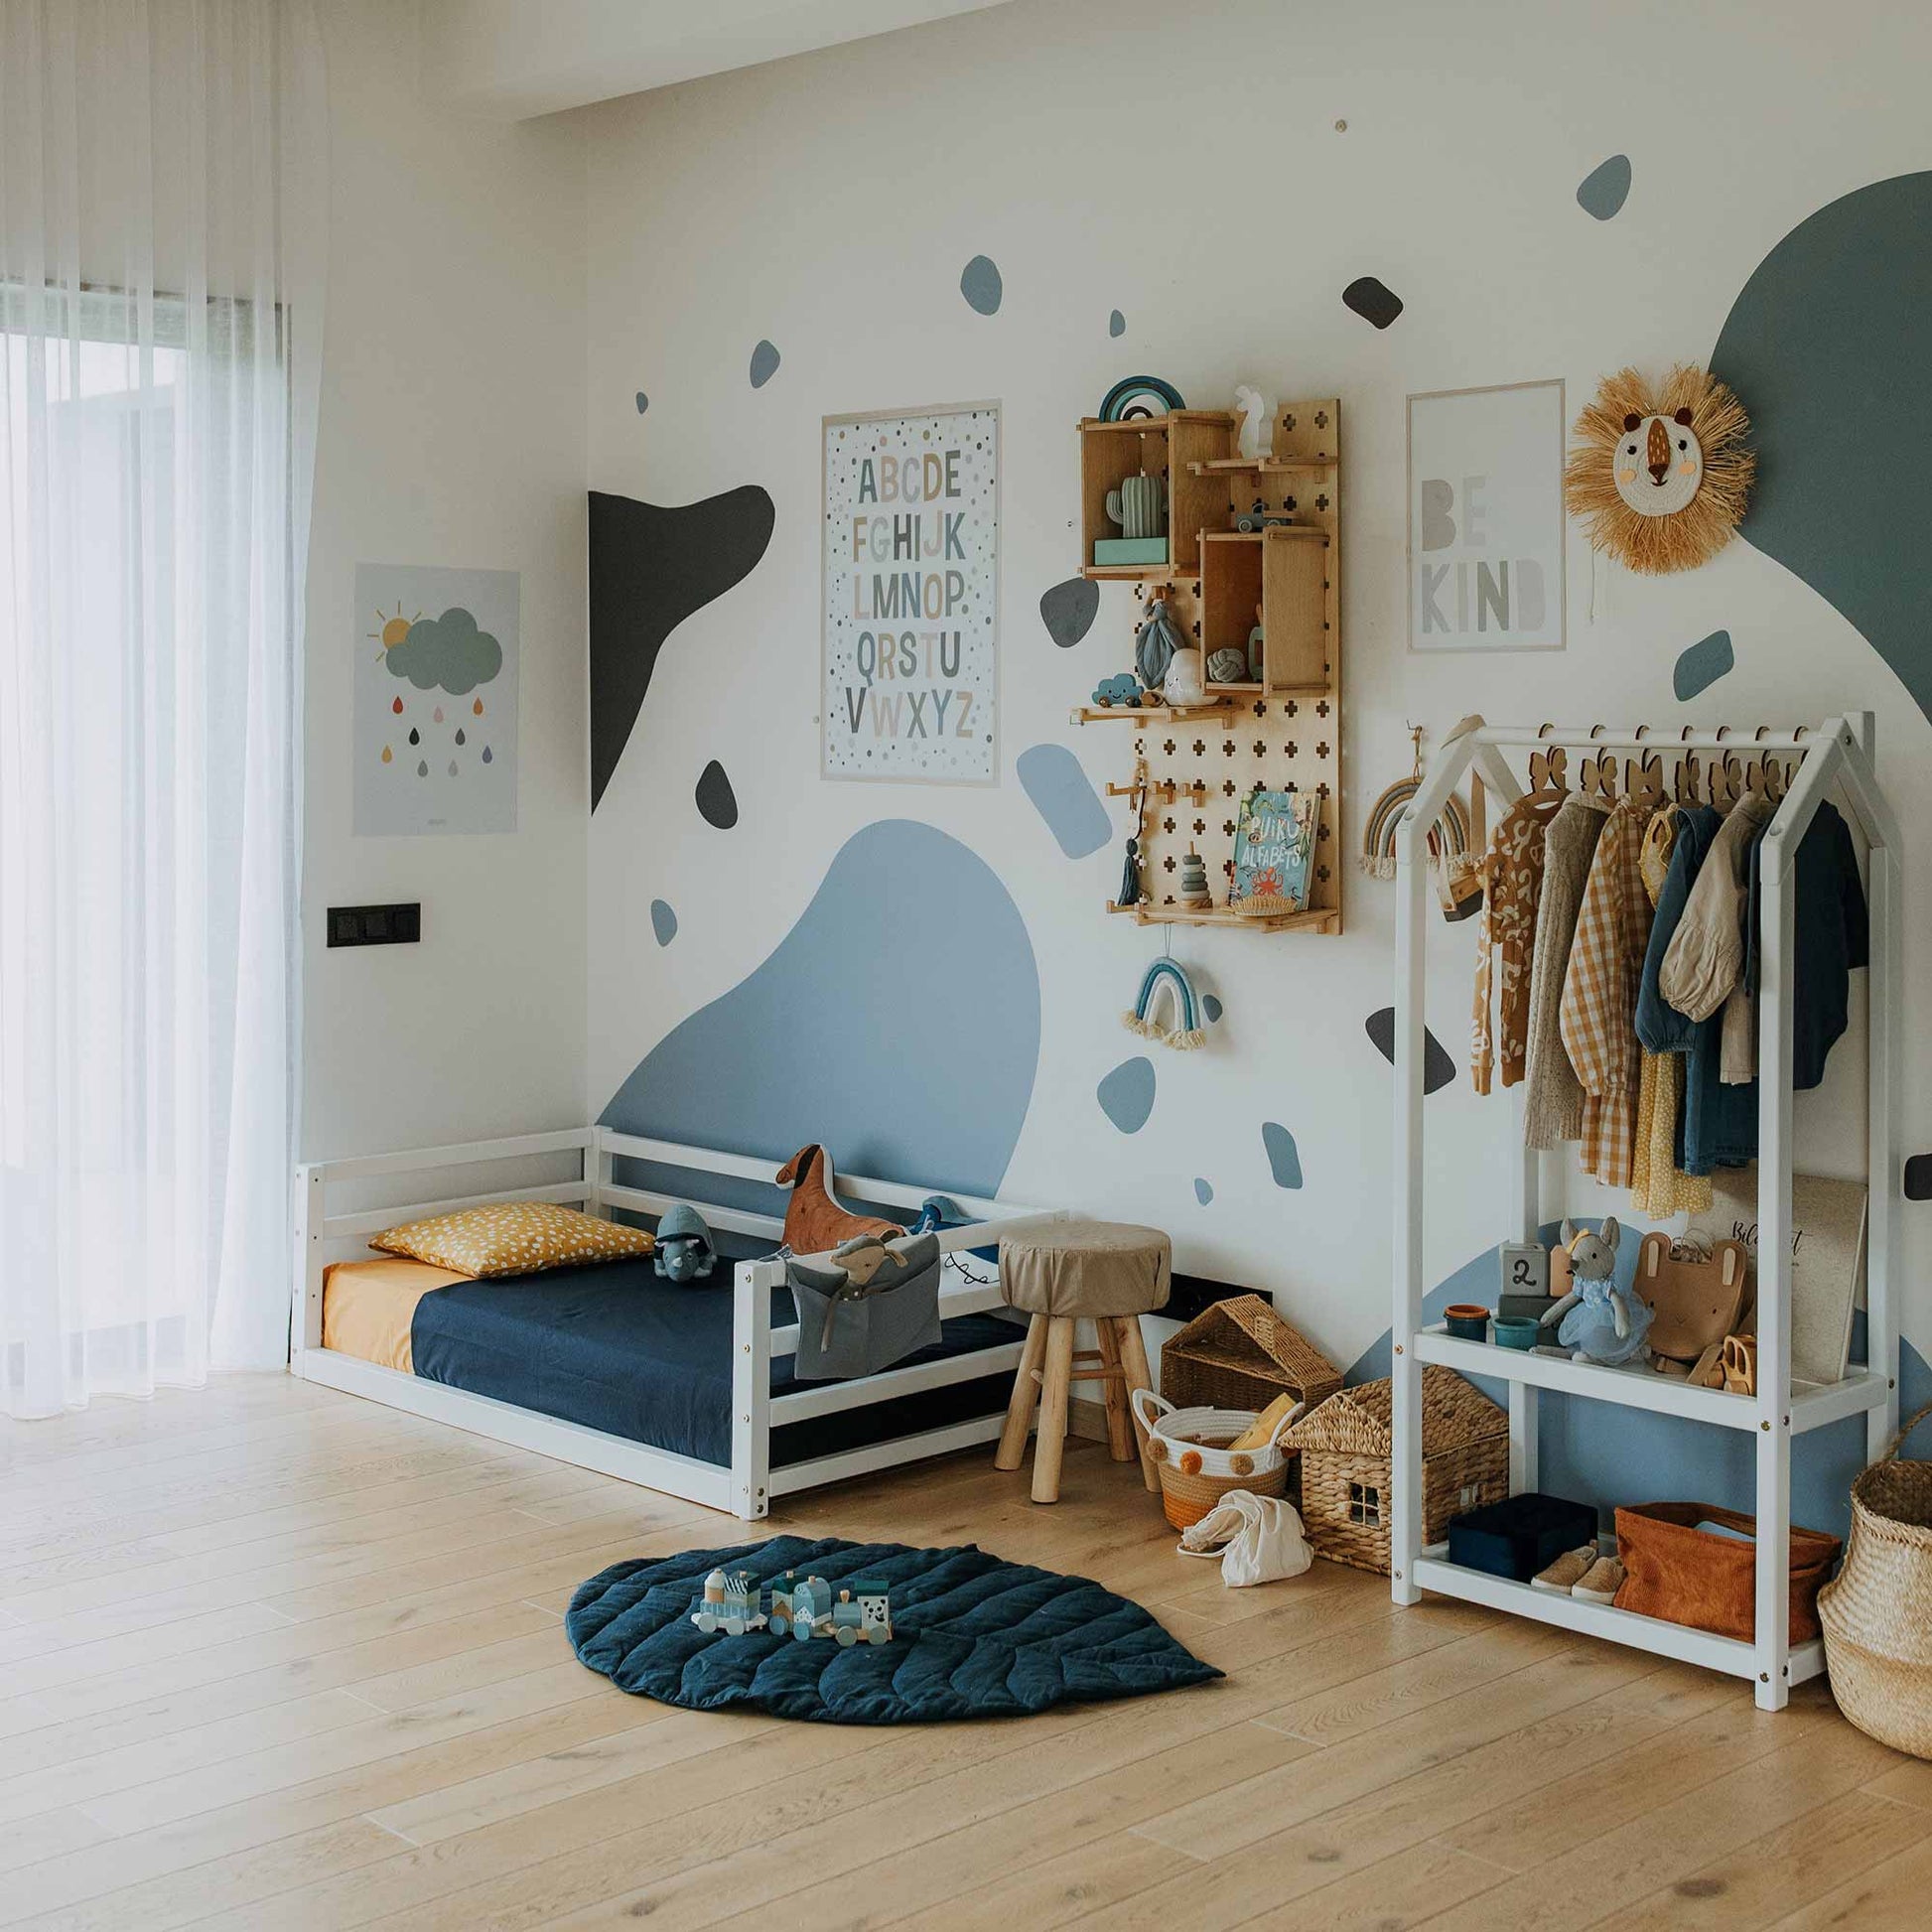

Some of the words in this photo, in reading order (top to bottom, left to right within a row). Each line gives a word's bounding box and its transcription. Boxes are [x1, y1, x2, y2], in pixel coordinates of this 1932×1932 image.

[858, 450, 961, 504] ABCDE
[853, 509, 966, 564] FGHIJK
[1422, 476, 1486, 551] BE
[854, 570, 965, 621] LMNOP
[1422, 560, 1546, 633] KIND
[857, 630, 961, 687] QRSTU
[846, 687, 973, 740] VWXYZ
[1512, 1259, 1537, 1286] 2
